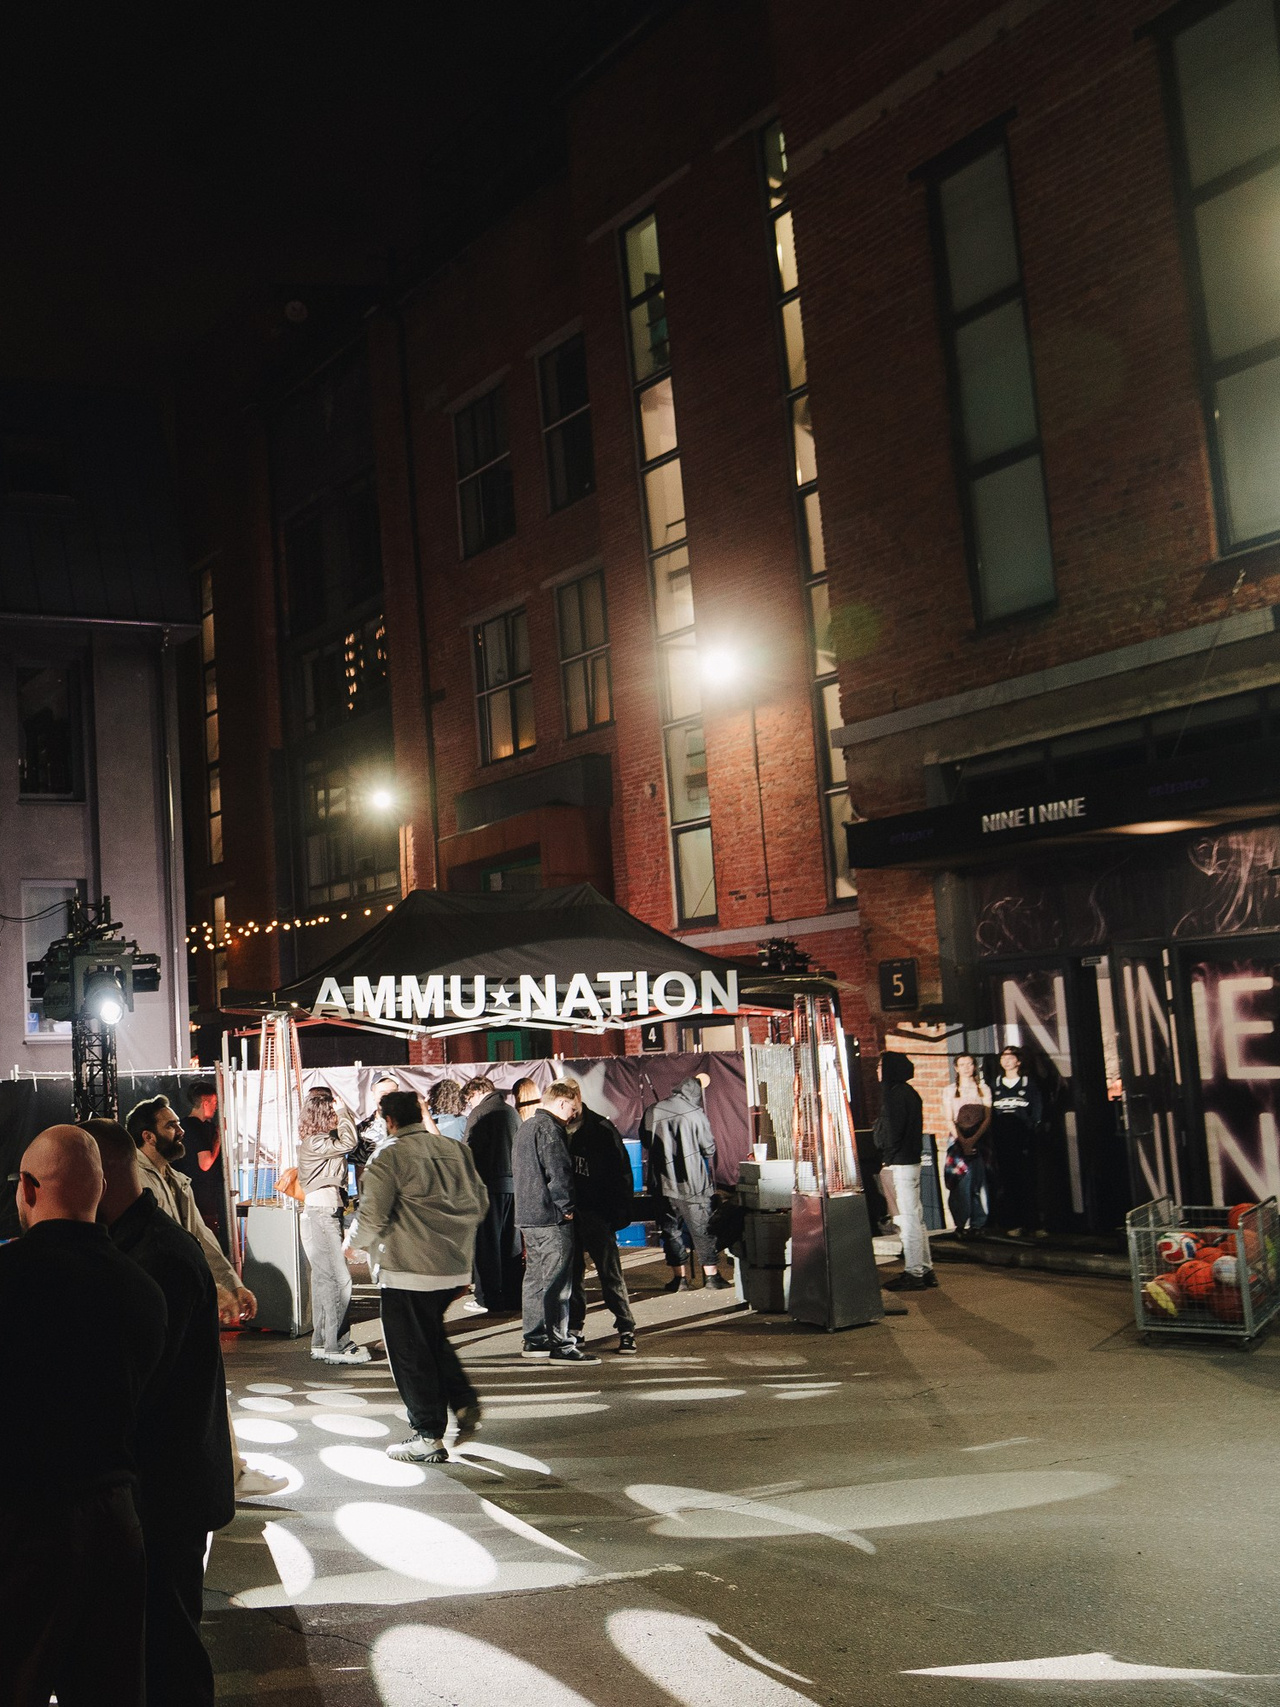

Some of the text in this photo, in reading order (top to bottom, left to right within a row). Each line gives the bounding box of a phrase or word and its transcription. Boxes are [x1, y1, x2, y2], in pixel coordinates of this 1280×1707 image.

[981, 808, 1025, 834] NINE
[1038, 797, 1087, 824] NINE
[892, 973, 905, 997] 5
[648, 1026, 657, 1043] 4
